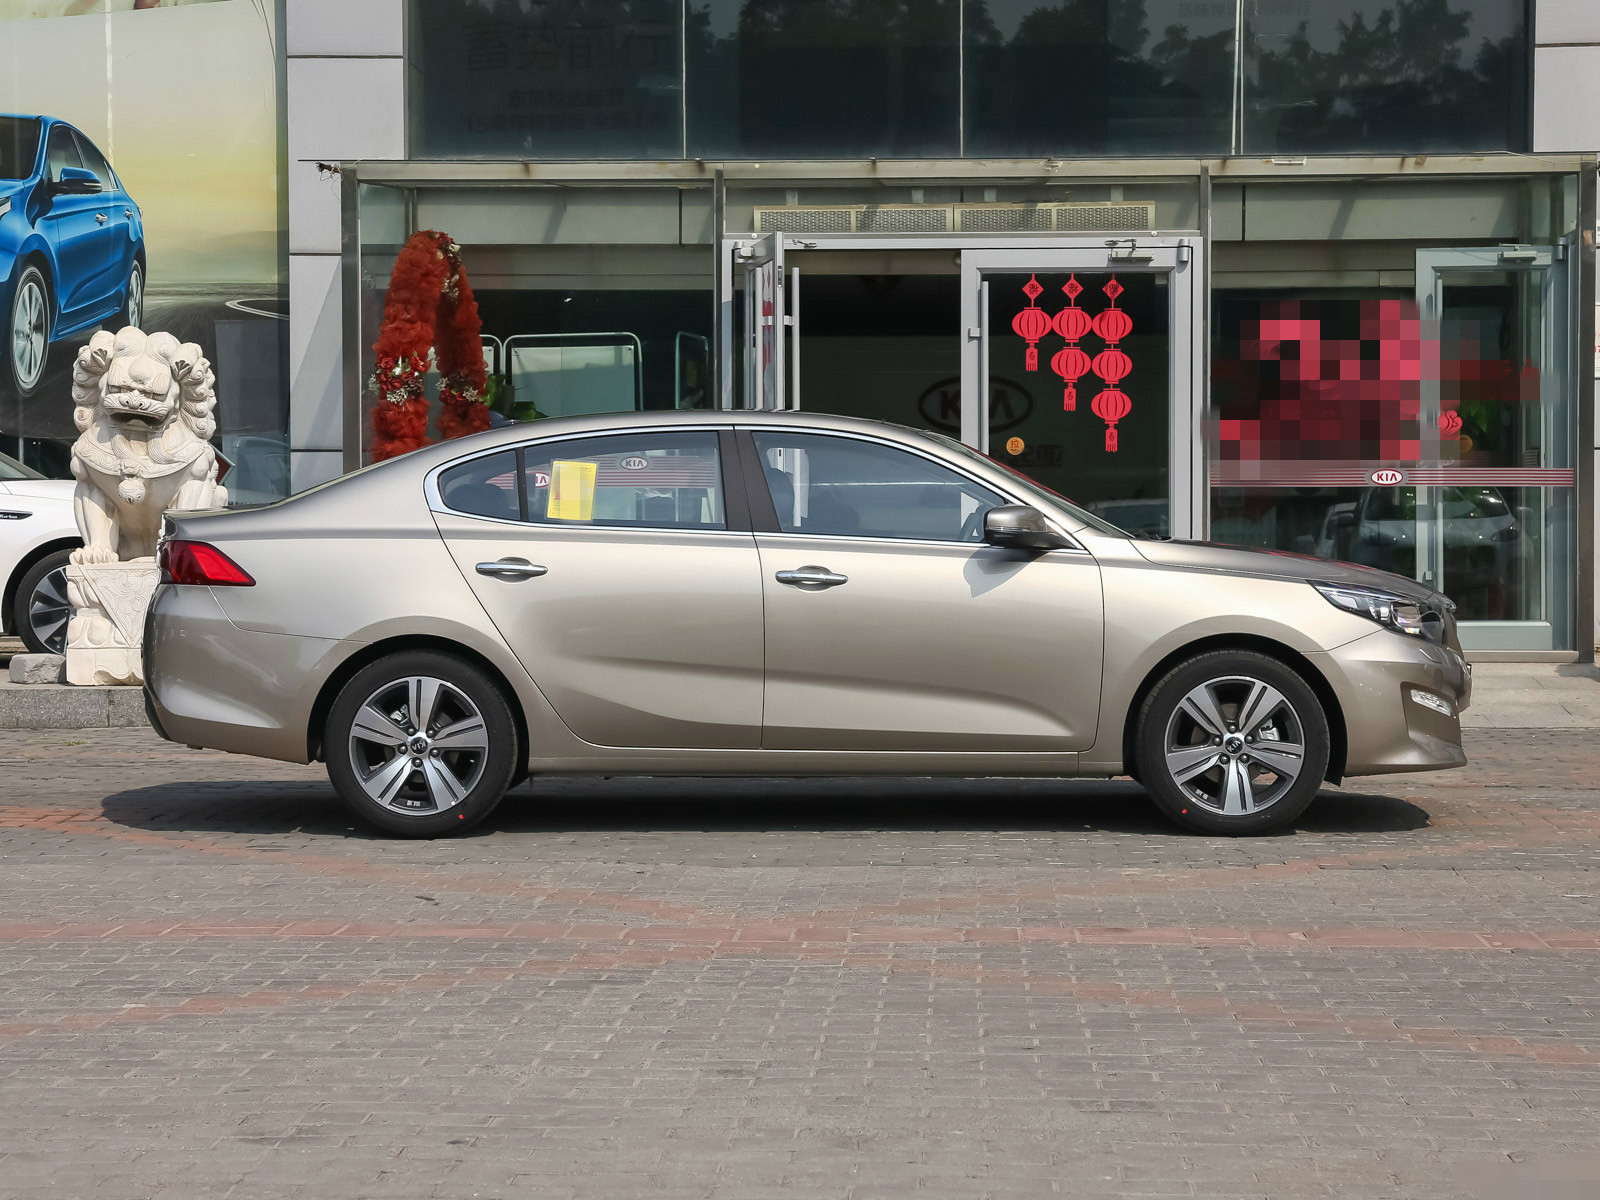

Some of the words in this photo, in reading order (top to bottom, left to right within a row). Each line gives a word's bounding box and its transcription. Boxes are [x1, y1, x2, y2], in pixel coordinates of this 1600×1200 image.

[940, 389, 1015, 420] KA
[625, 459, 644, 467] KIA
[1377, 473, 1398, 481] KIA
[411, 740, 427, 751] KIA
[1227, 740, 1241, 752] KIA
